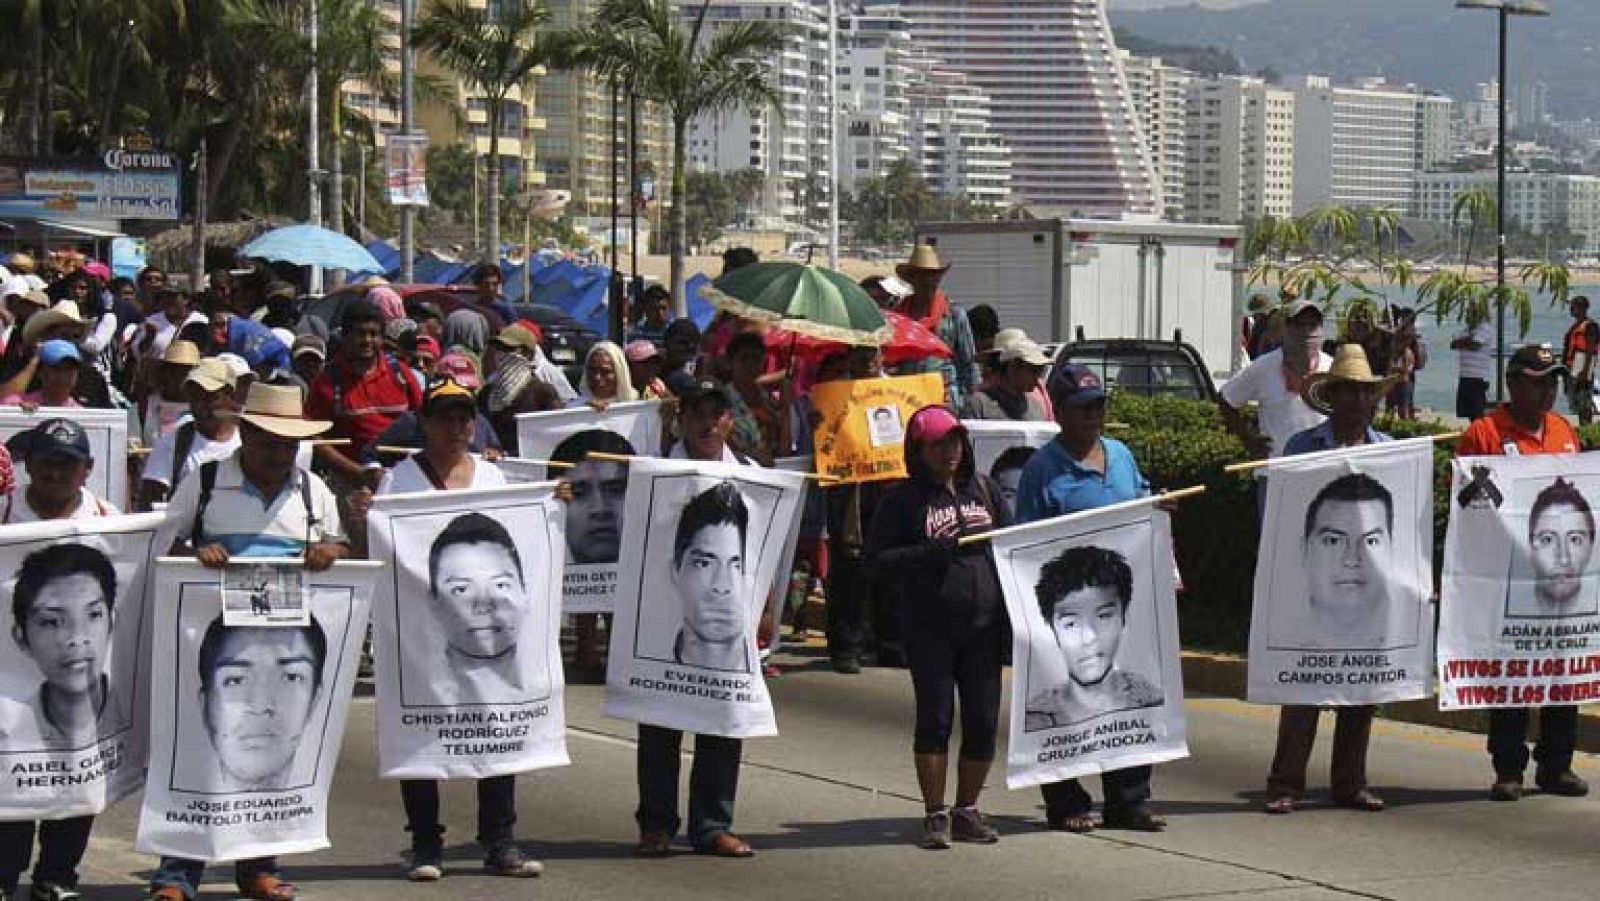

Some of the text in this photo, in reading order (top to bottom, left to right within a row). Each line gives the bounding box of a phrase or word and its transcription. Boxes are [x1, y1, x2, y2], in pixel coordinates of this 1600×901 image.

[104, 149, 172, 169] Corona
[1515, 636, 1589, 651] DE LA CRUZ
[1279, 668, 1407, 685] CAMPOS CANTOR
[1506, 658, 1530, 678] SE
[1533, 657, 1566, 677] LOS
[1456, 685, 1508, 706] VIVOS
[1512, 685, 1545, 704] LOS
[401, 705, 549, 725] CHISTIAN ALFONSO
[443, 740, 524, 756] TELUMBRE
[1037, 732, 1156, 762] CRUZ MENDOZA
[1042, 729, 1091, 748] JORGE
[11, 760, 74, 775] ABEL
[233, 794, 303, 810] EDUARDO
[166, 806, 314, 827] BARTOLO TLATEMPA
